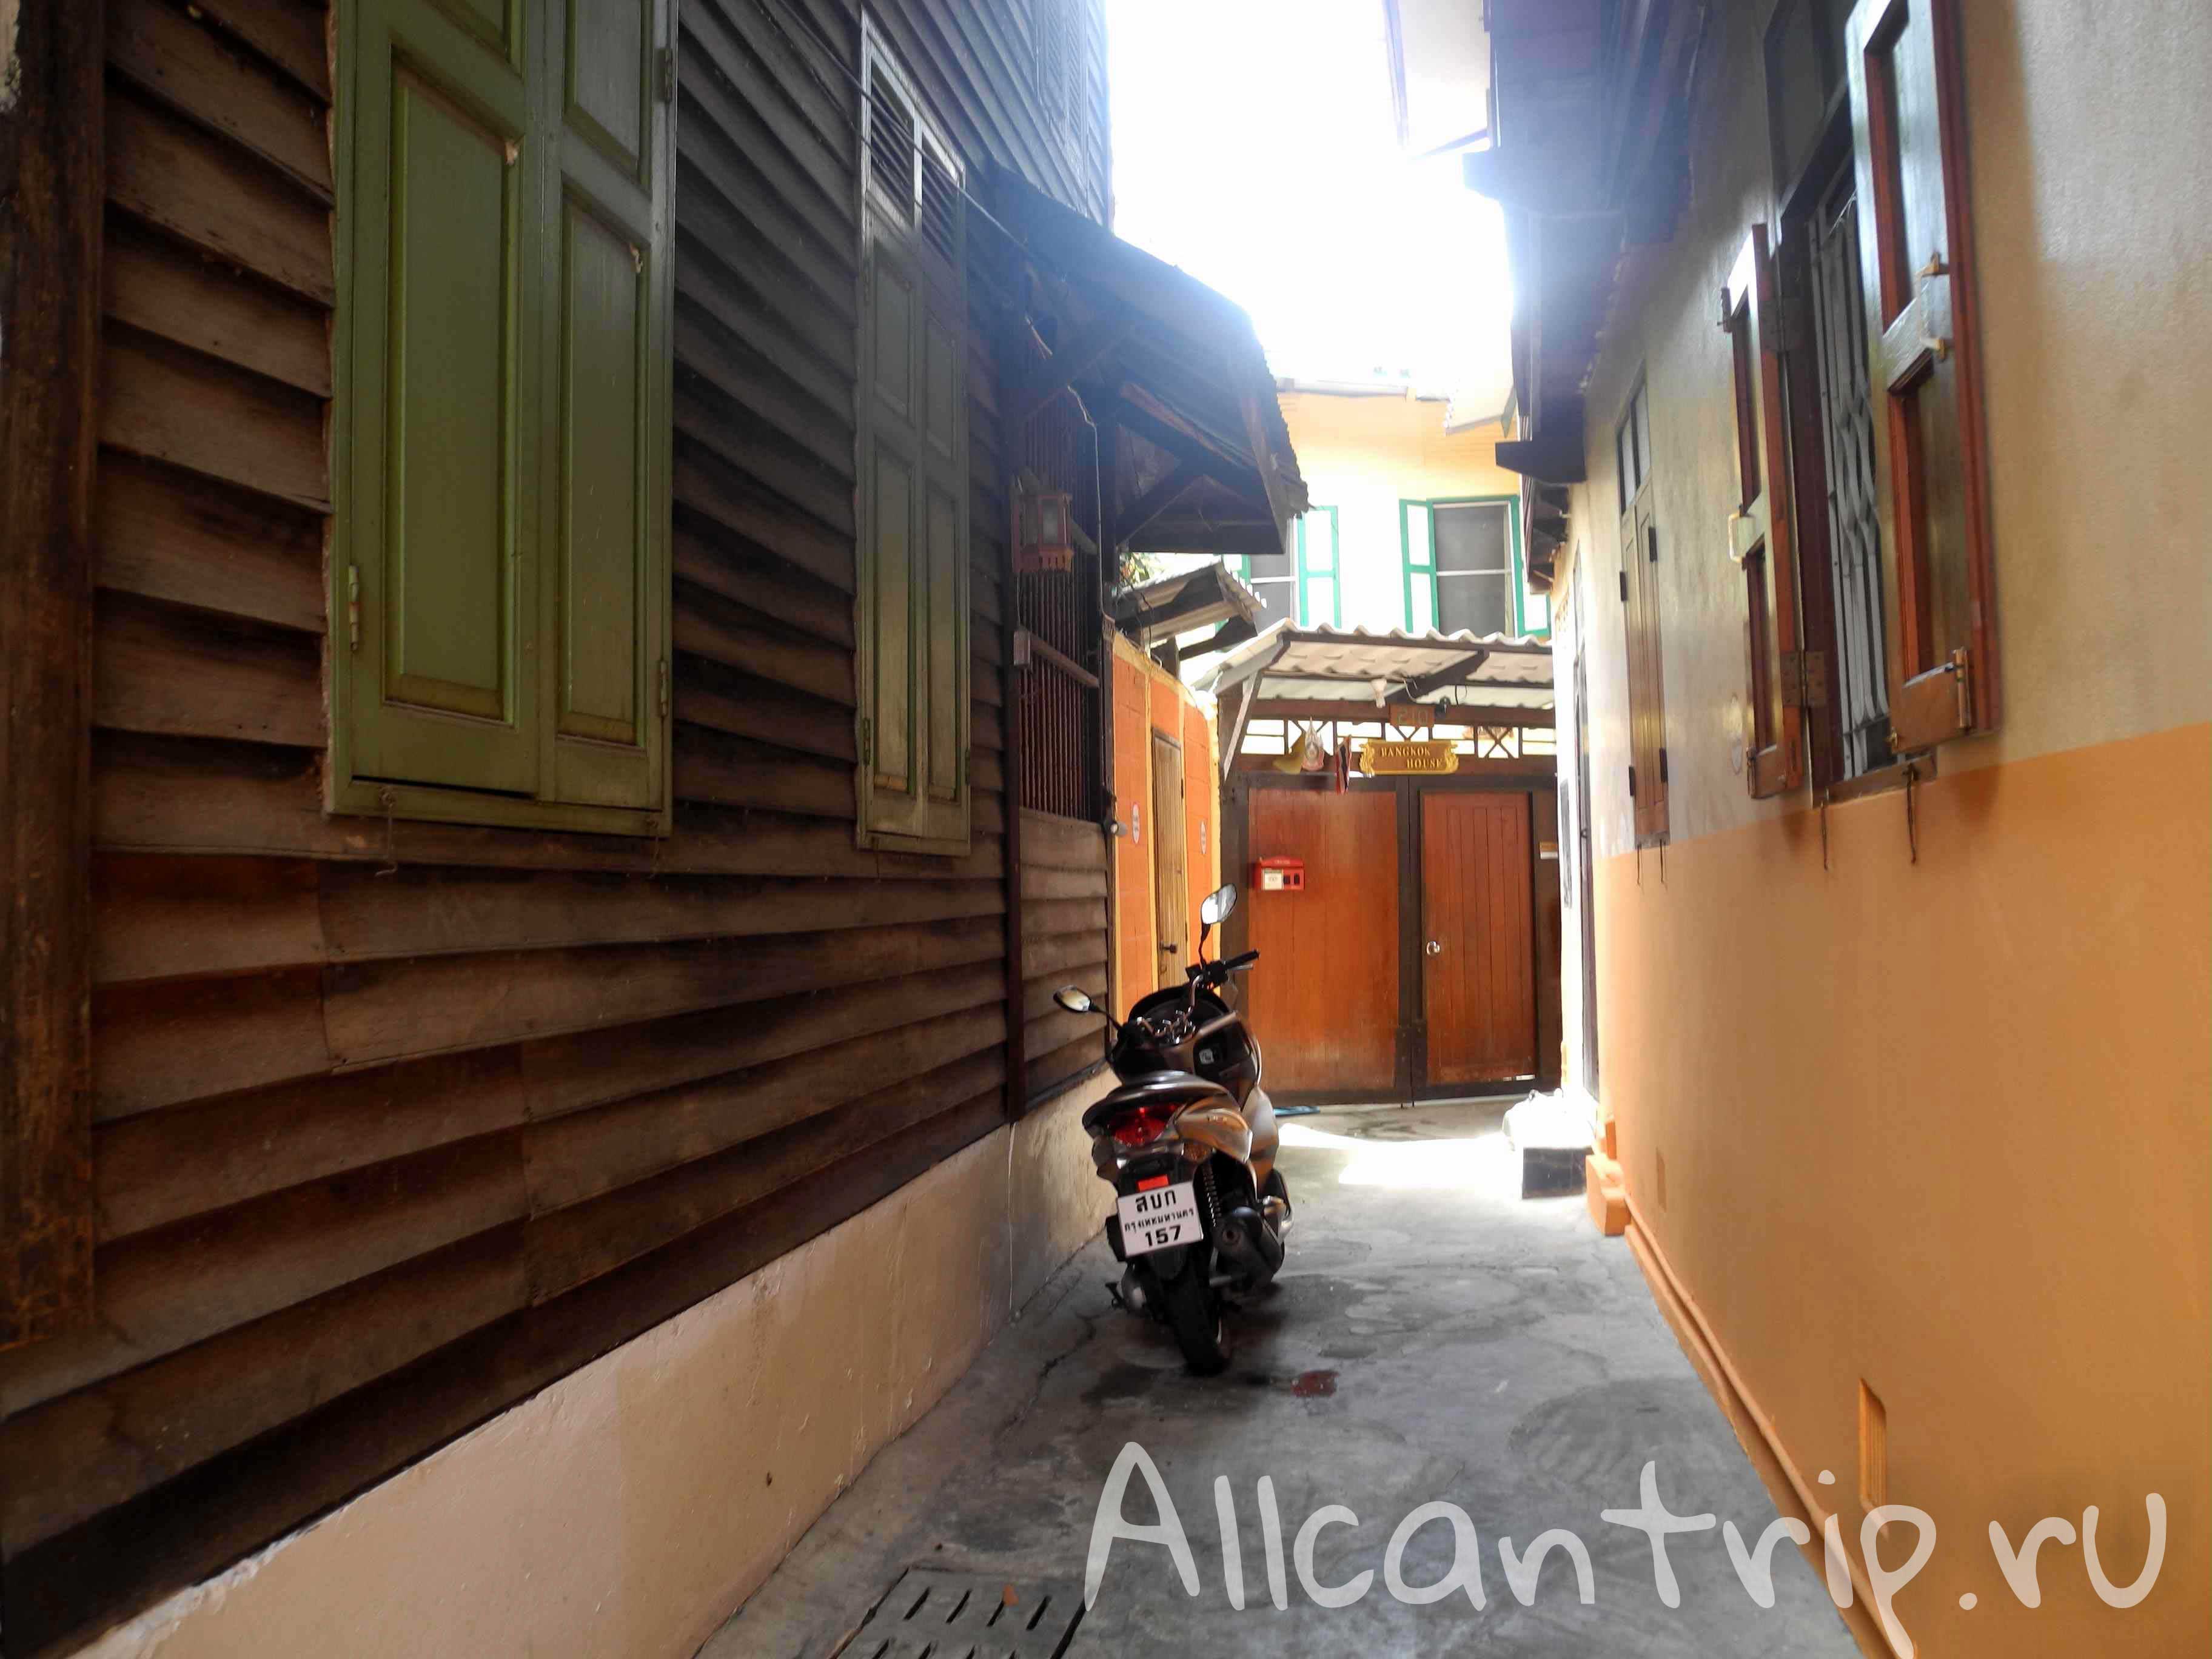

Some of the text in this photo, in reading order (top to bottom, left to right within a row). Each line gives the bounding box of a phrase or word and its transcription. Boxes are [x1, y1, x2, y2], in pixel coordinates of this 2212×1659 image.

[1381, 746, 1431, 757] BANGKOK
[1407, 758, 1442, 768] HOUSE
[1145, 1225, 1181, 1247] 157
